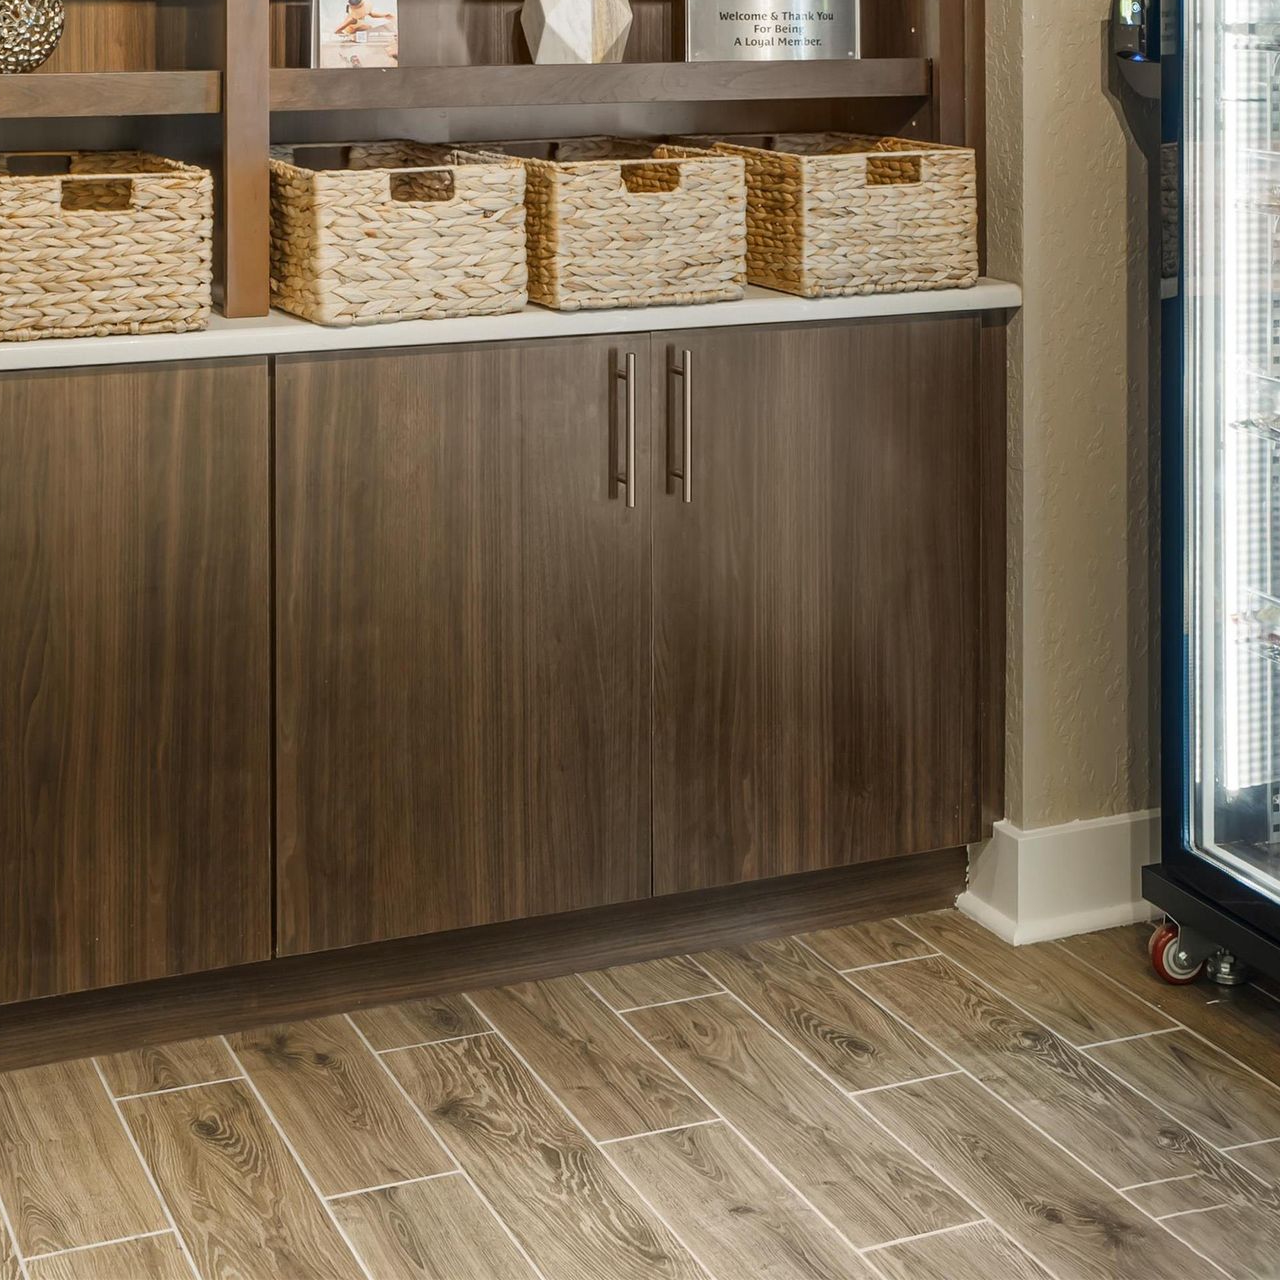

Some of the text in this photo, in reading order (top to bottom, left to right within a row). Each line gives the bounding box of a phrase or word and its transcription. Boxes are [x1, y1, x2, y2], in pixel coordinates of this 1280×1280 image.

[719, 11, 834, 21] Welcome & Thank You
[754, 24, 804, 36] For Being
[733, 37, 822, 49] A Loyal Member.
